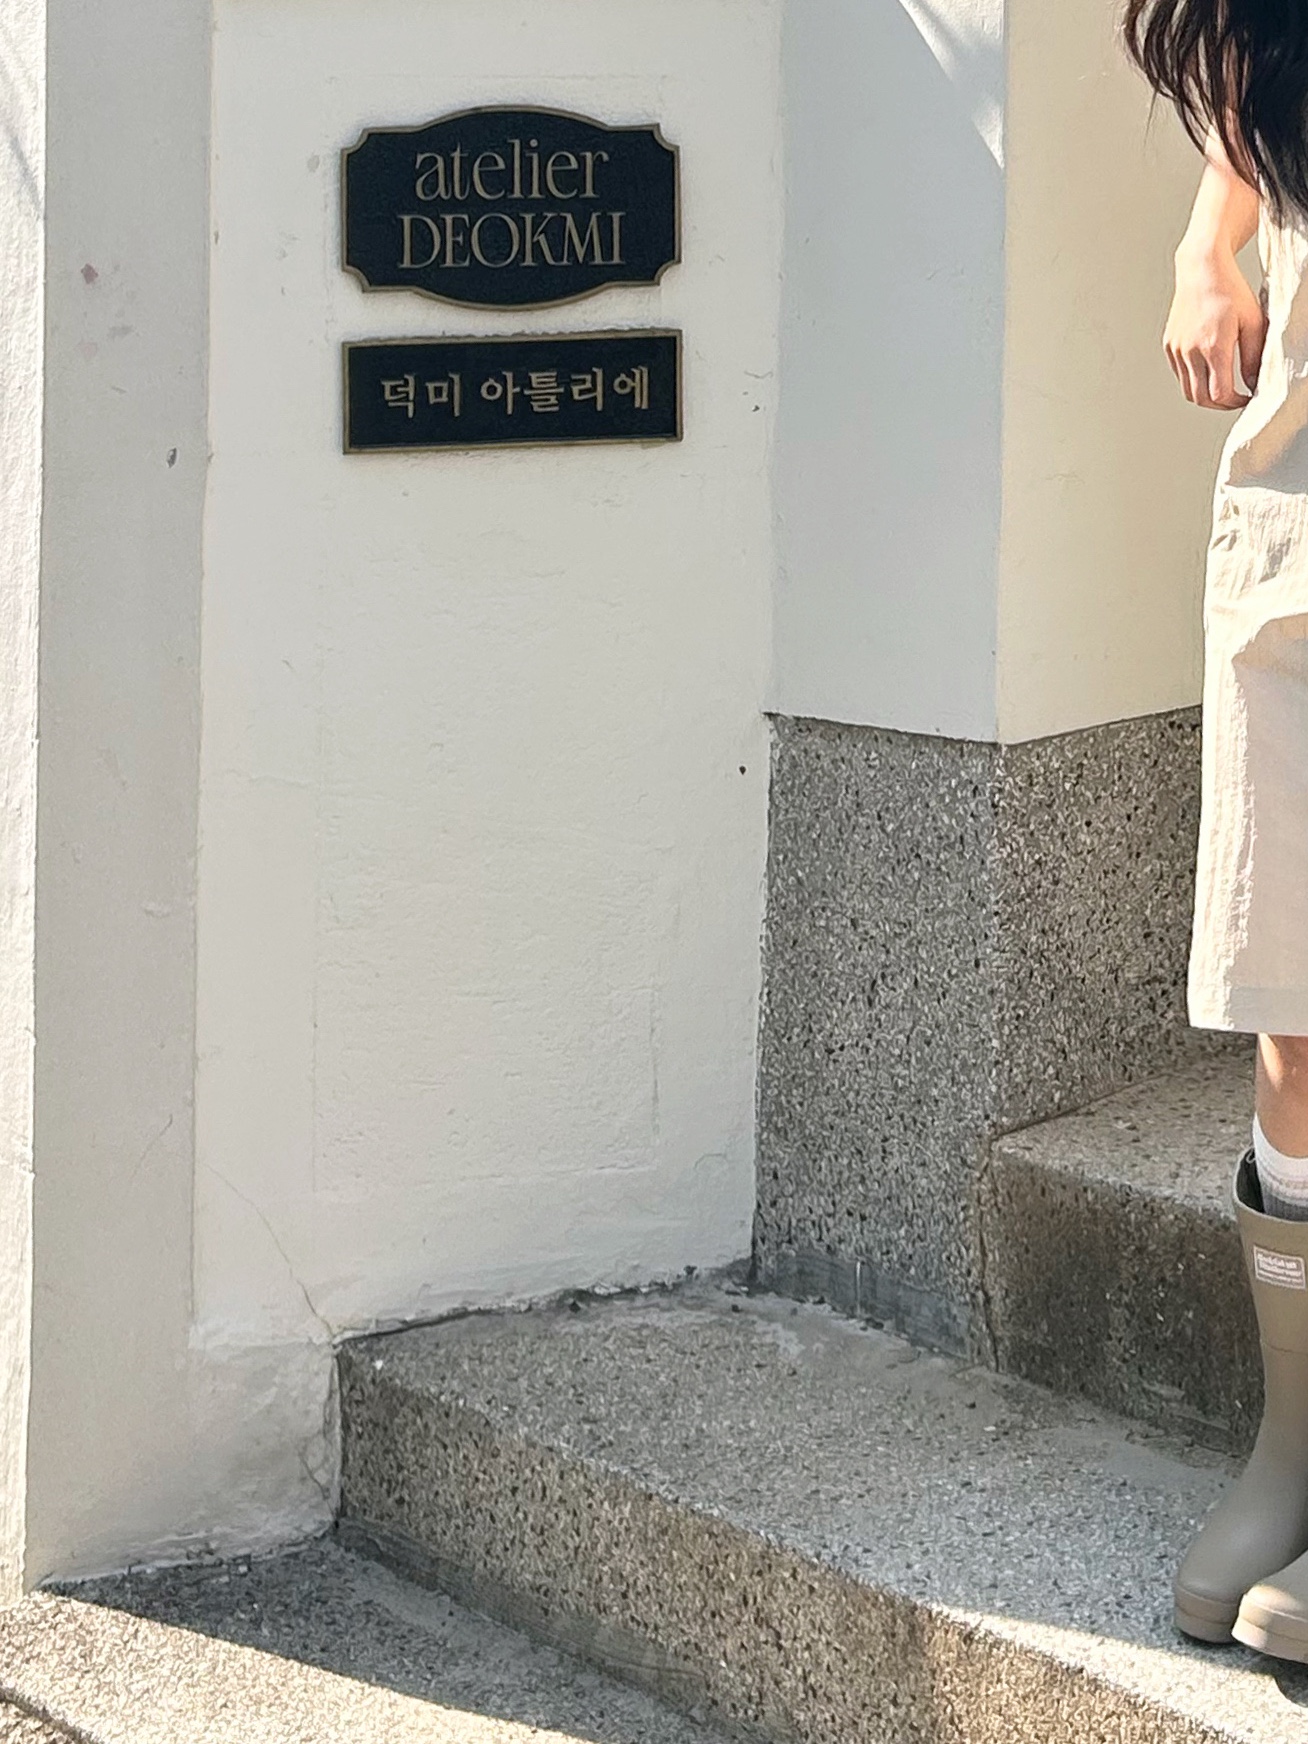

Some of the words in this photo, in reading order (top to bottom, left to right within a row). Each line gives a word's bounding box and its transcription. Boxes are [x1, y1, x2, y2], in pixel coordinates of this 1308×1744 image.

[414, 138, 610, 202] atelier
[397, 211, 627, 270] DEOKMI
[380, 372, 462, 419] 덕미
[479, 365, 649, 416] 아틀리에
